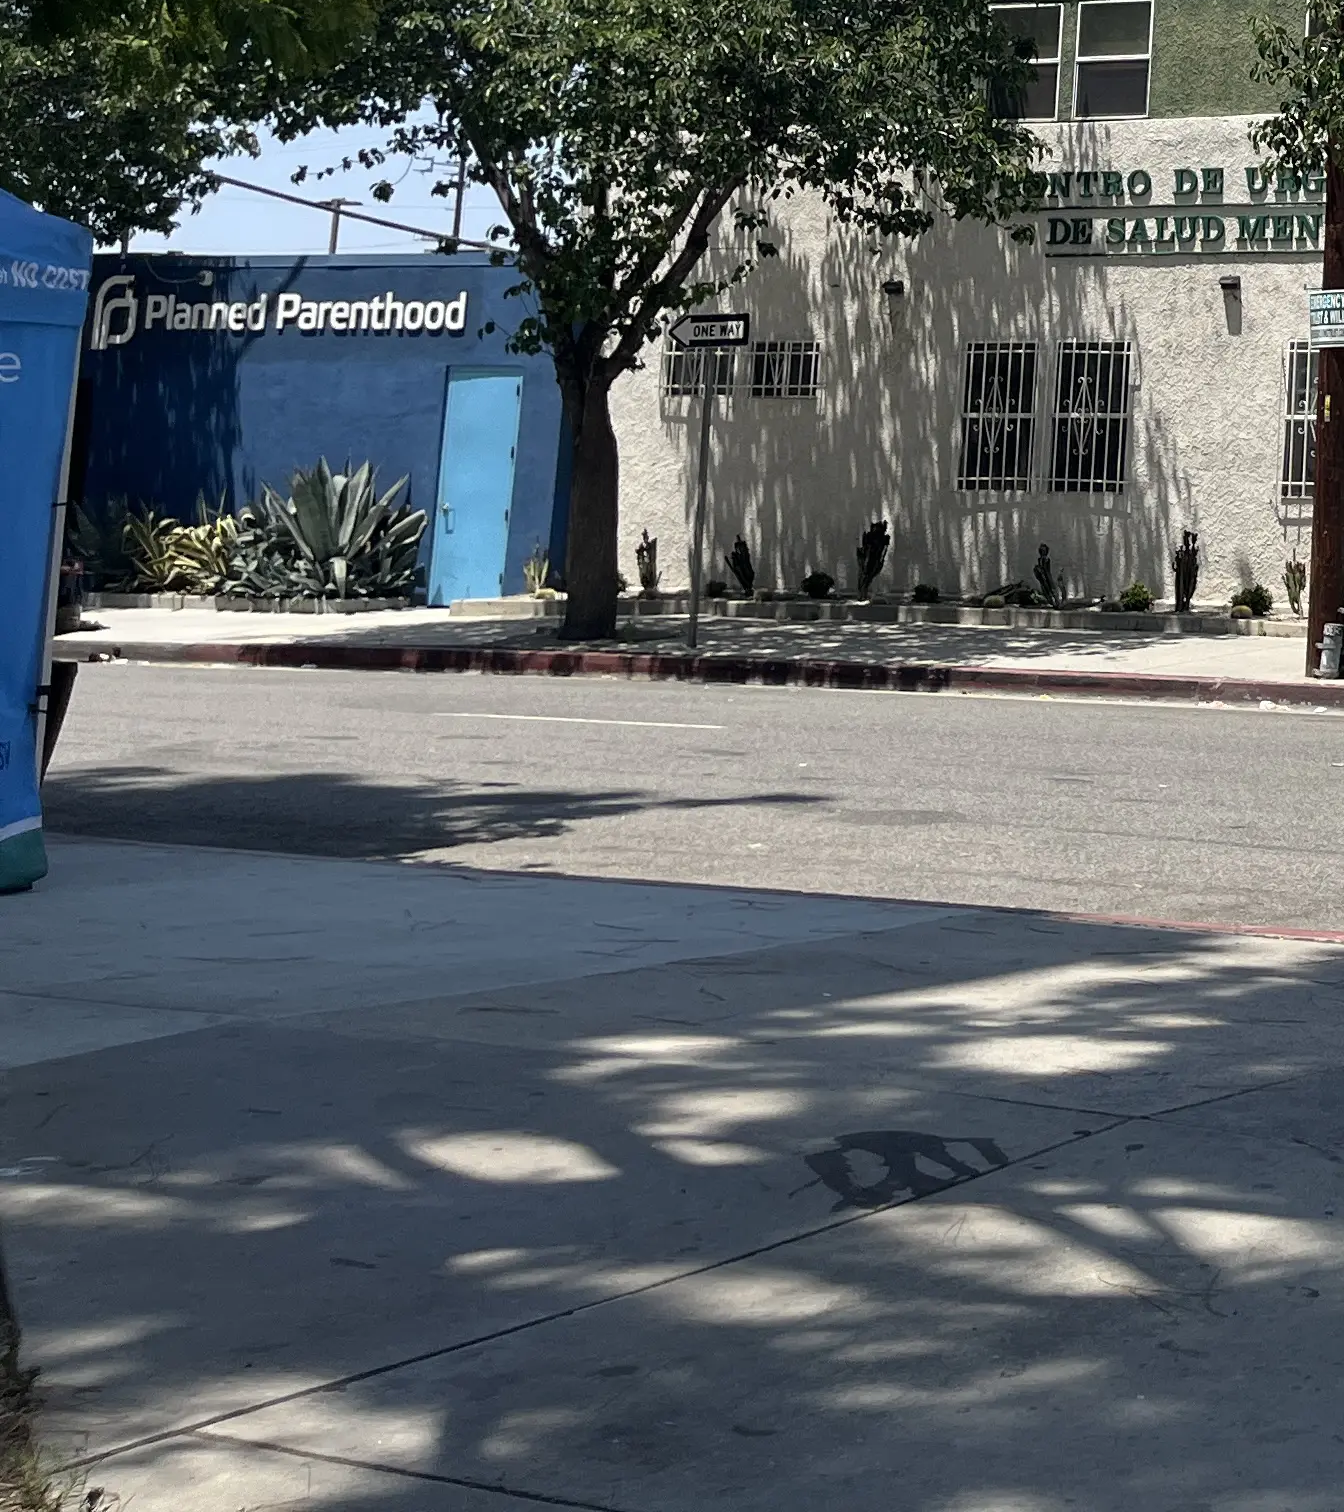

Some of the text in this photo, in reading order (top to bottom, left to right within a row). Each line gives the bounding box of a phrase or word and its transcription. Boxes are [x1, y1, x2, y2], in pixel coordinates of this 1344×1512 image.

[1022, 169, 1151, 198] NTRO
[1173, 167, 1224, 195] DE
[1046, 217, 1092, 245] DE
[1105, 215, 1225, 244] SALUD
[145, 292, 467, 330] Planned Parenthood
[693, 324, 742, 337] ONE WAY
